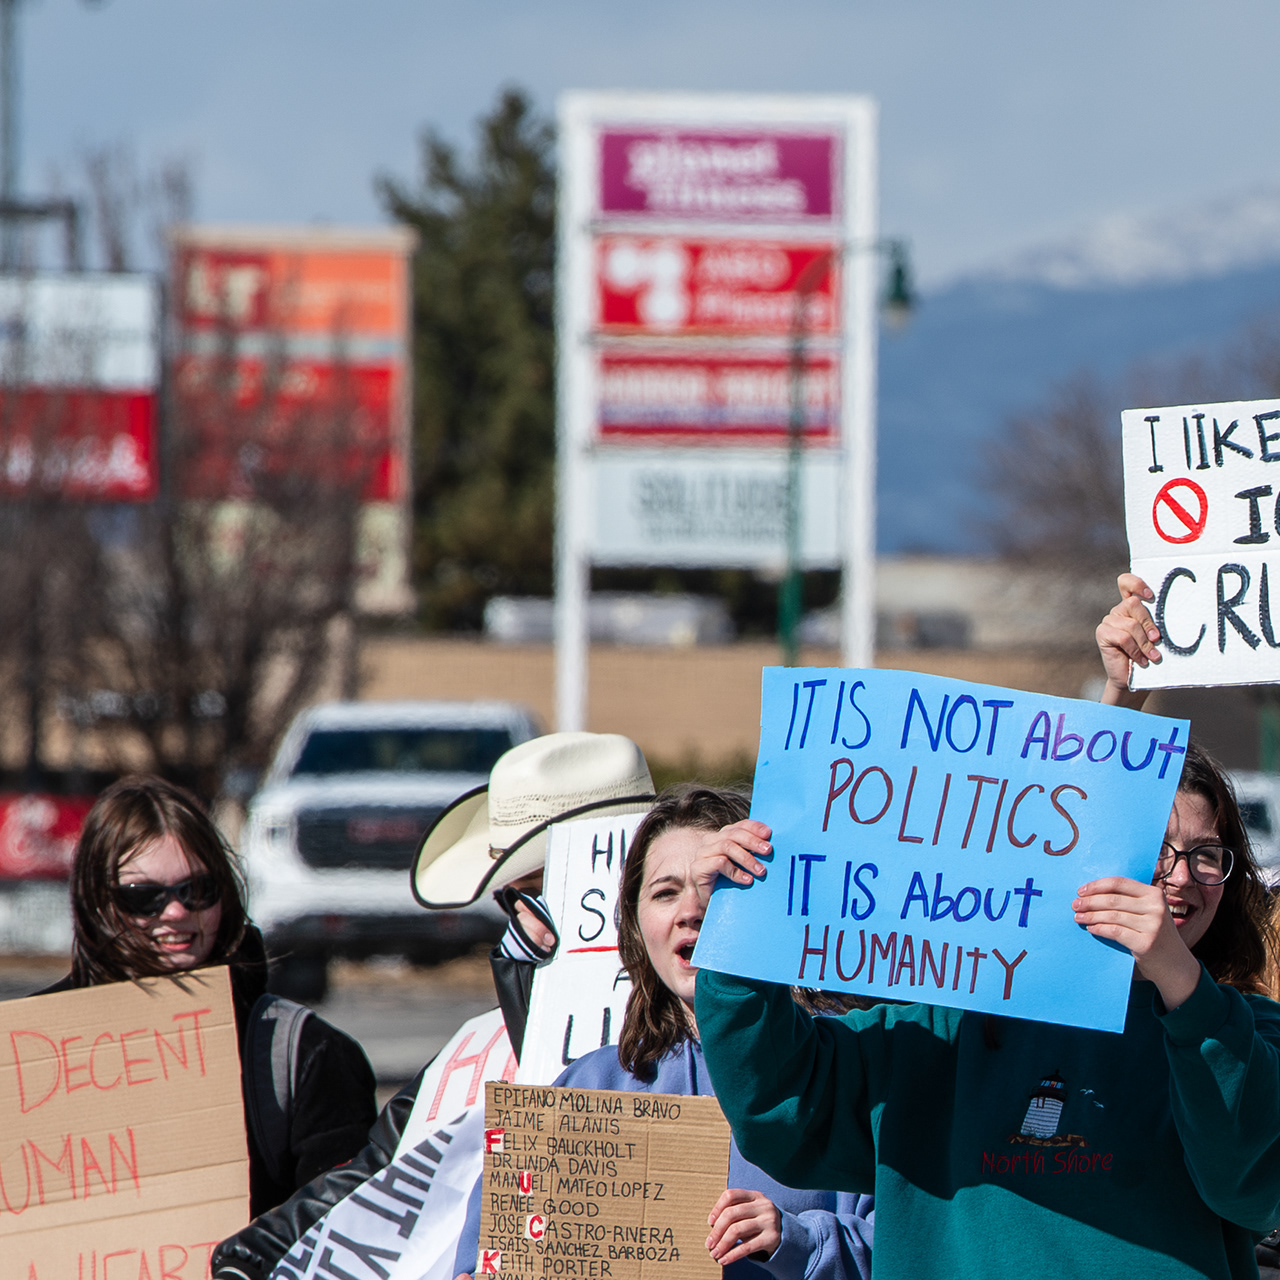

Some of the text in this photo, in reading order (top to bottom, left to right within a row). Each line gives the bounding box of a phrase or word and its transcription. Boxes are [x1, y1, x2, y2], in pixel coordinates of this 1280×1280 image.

[1144, 415, 1164, 473] I
[784, 679, 827, 751] IT
[831, 680, 872, 750] IS
[900, 688, 1014, 756] NOT
[822, 757, 1088, 856] POLITICS
[787, 854, 827, 917] IT
[840, 861, 879, 921] IS
[10, 1008, 212, 1114] DECENT
[494, 1088, 681, 1120] EPIFANO MOLINA BRAVO
[495, 1109, 620, 1135] JAIME ALANIS
[484, 1128, 636, 1160] FELIX BAUCKHOLT
[0, 1127, 141, 1215] UMAN
[492, 1153, 618, 1177] DR LINDA DAVIS
[982, 1147, 1114, 1174] North Shore
[490, 1171, 665, 1201] MANUEL MATEO LOPEZ
[543, 1199, 600, 1217] GOOD
[489, 1214, 524, 1236] JOSE
[482, 1250, 612, 1277] KEITH PORTER
[488, 1235, 680, 1262] ISAIS SANCHEZ BARBOZA
